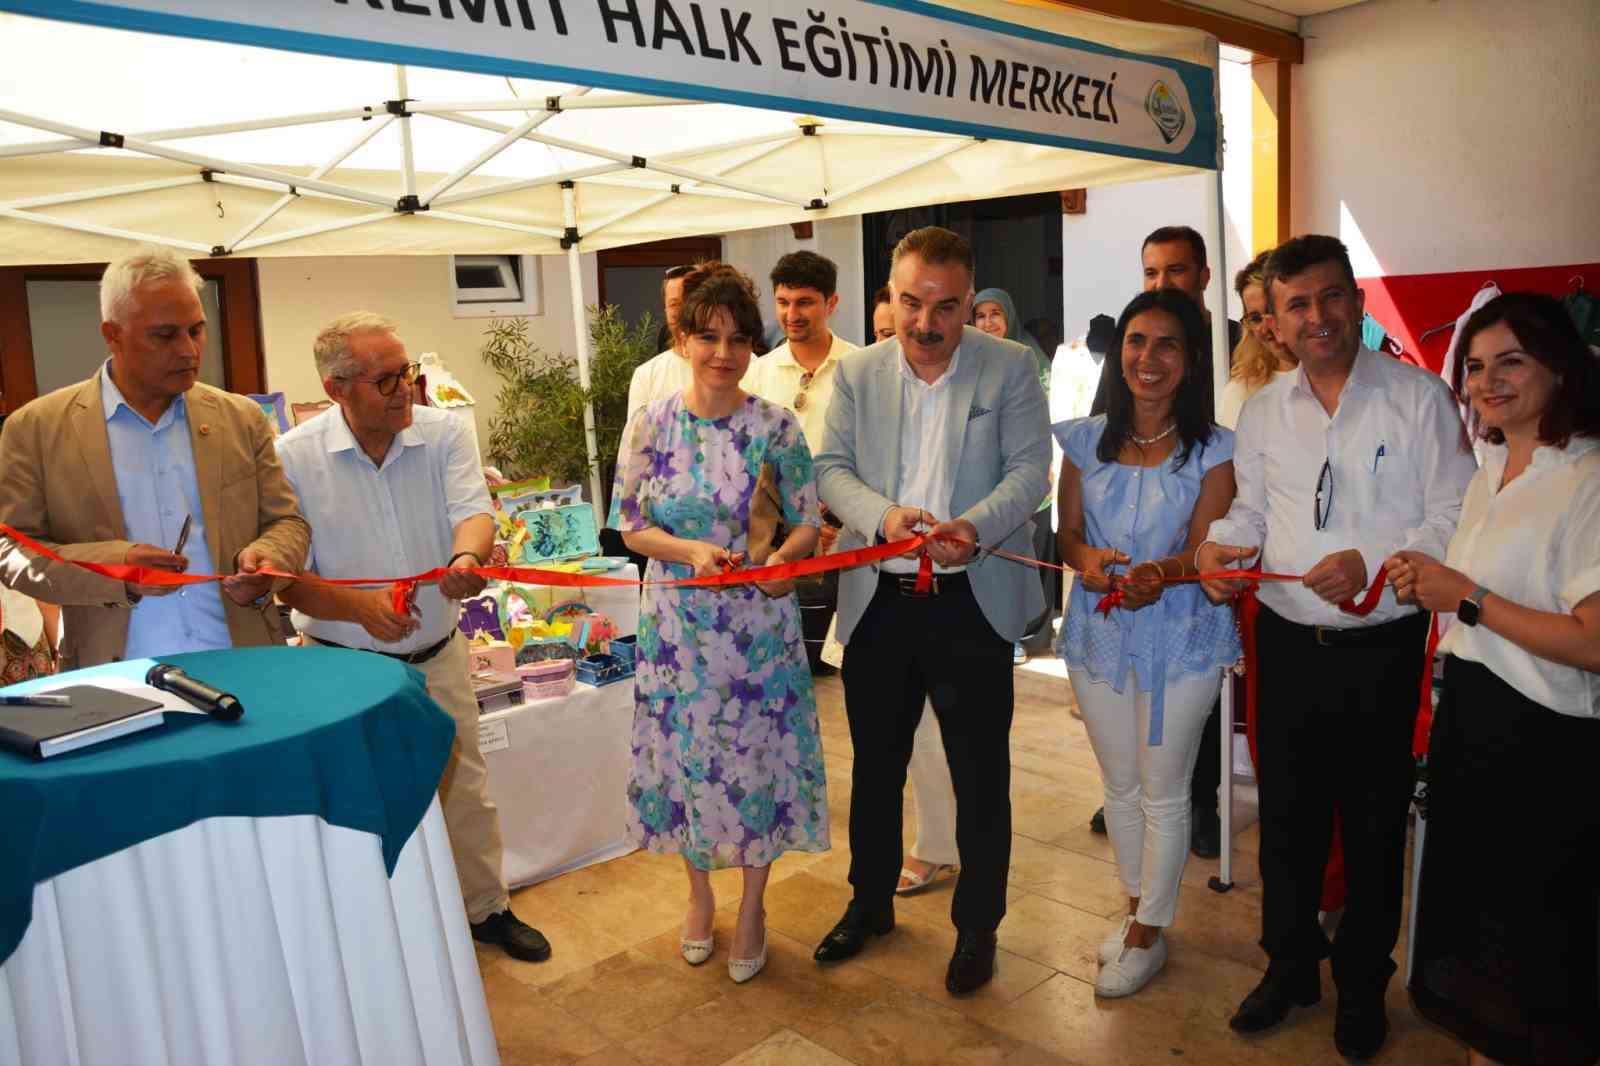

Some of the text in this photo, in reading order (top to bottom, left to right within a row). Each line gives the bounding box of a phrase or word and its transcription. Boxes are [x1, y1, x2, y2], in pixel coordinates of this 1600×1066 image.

[596, 0, 762, 66] HALK
[772, 8, 957, 98] EĞİTİMİ
[969, 54, 1119, 124] MERKEZİ
